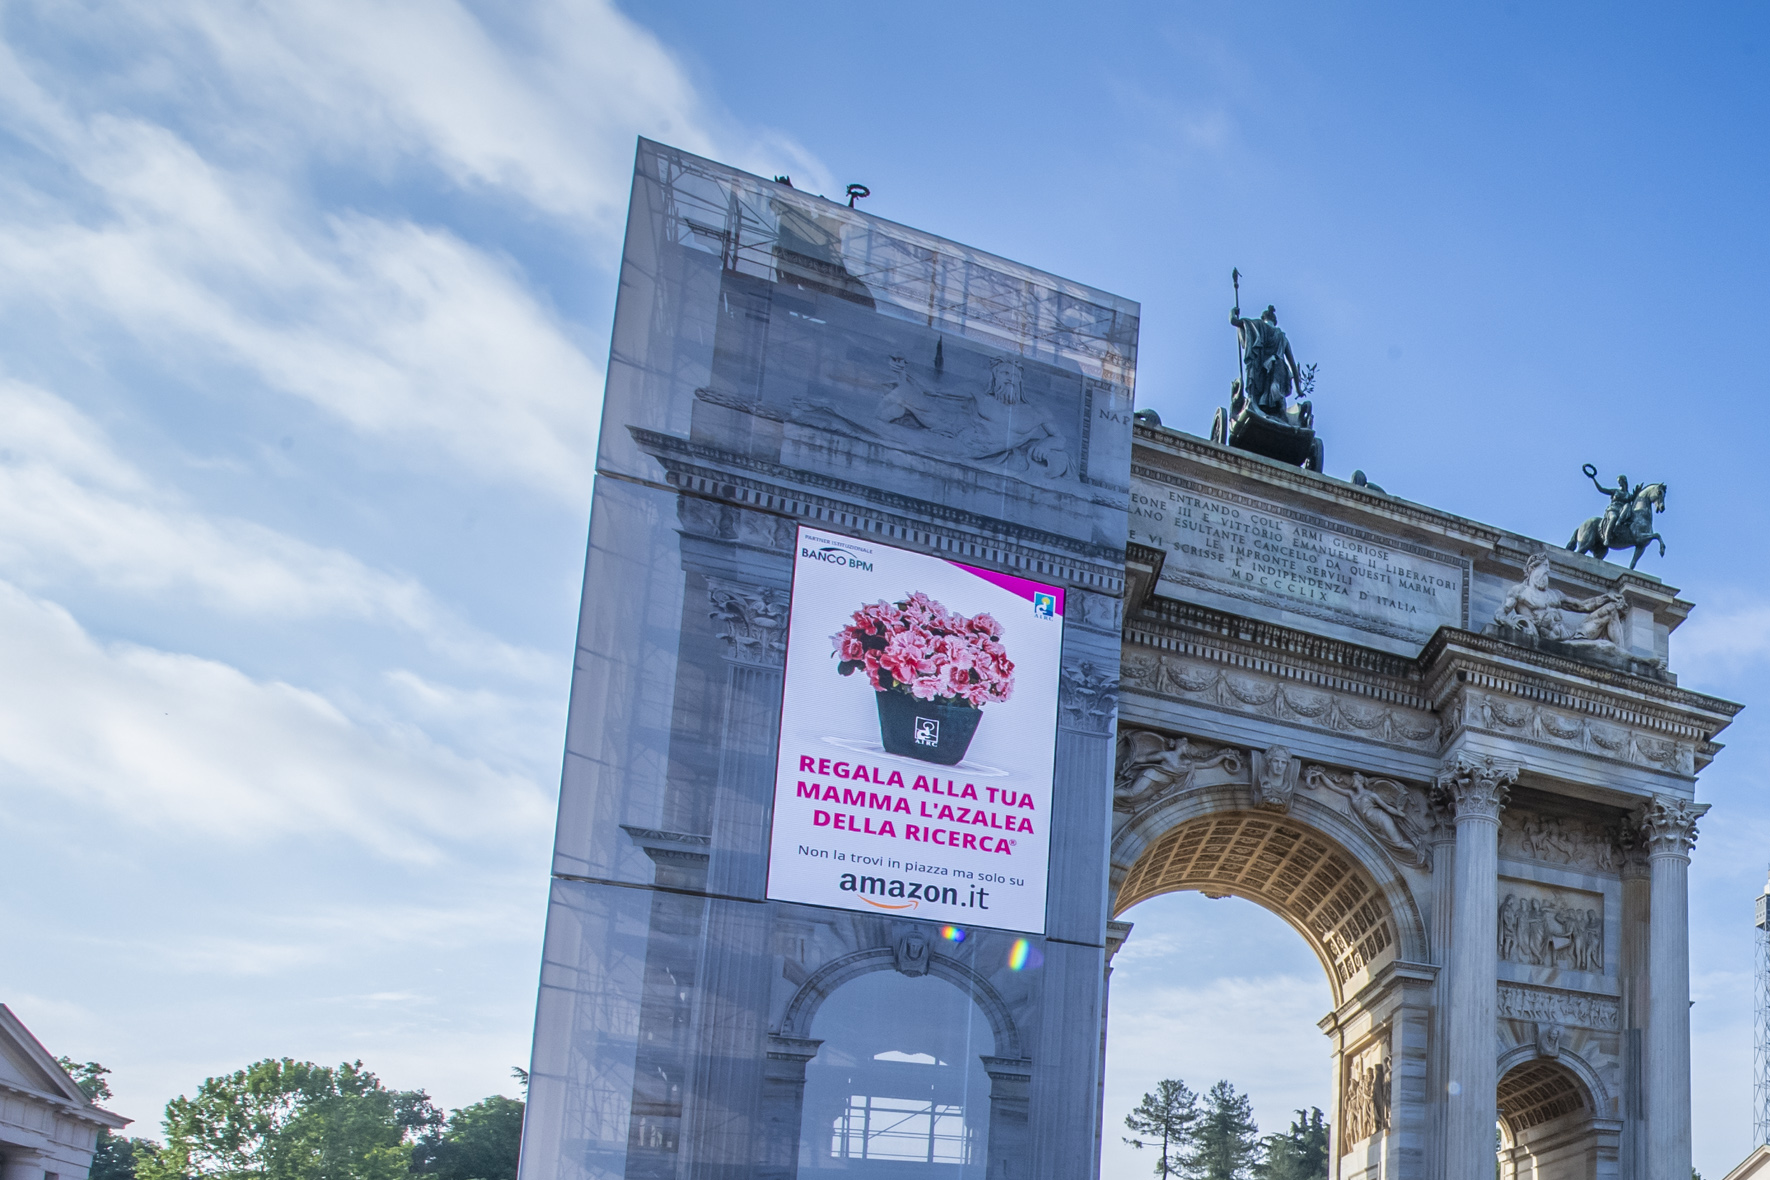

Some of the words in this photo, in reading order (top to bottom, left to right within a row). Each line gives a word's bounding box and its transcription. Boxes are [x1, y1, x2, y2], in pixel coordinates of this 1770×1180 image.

[1131, 493, 1167, 511] EONE
[1178, 506, 1192, 518] III
[1202, 512, 1210, 523] E
[1220, 517, 1283, 543] VITTORIO
[1292, 537, 1359, 564] EMANUELE
[1386, 563, 1457, 591] LIBERATORI
[1169, 491, 1240, 519] ENTRANDO
[1292, 526, 1323, 542] ARMI
[1332, 537, 1390, 561] GLORIOSE
[801, 547, 847, 566] BANCO
[848, 558, 874, 572] BPM
[1148, 533, 1163, 547] VI
[1174, 541, 1225, 563] SCRISSE
[1252, 562, 1349, 596] INDIPENDENZA
[1377, 595, 1417, 614] ITALIA
[1174, 517, 1245, 545] ESULTANTE
[1325, 558, 1342, 571] DA
[1350, 565, 1391, 584] QUESTI
[1399, 578, 1437, 597] MARMI
[1205, 537, 1220, 550] LE
[1230, 544, 1296, 570] IMPRONTE
[1305, 565, 1353, 586] SERVILI
[795, 780, 912, 815] MAMMA
[920, 800, 1035, 835] L'AZALEA
[798, 754, 905, 789] REGALA
[911, 774, 979, 801] ALLA
[985, 786, 1036, 811] TUA
[812, 808, 897, 839] DELLA
[798, 844, 829, 860] Non
[833, 849, 847, 862] la
[850, 851, 885, 868] trovi
[888, 855, 901, 869] in
[904, 859, 949, 877] piazza
[953, 866, 975, 880] ma
[978, 868, 1006, 884] solo
[1009, 874, 1026, 887] su
[839, 872, 990, 911] amazon.it
